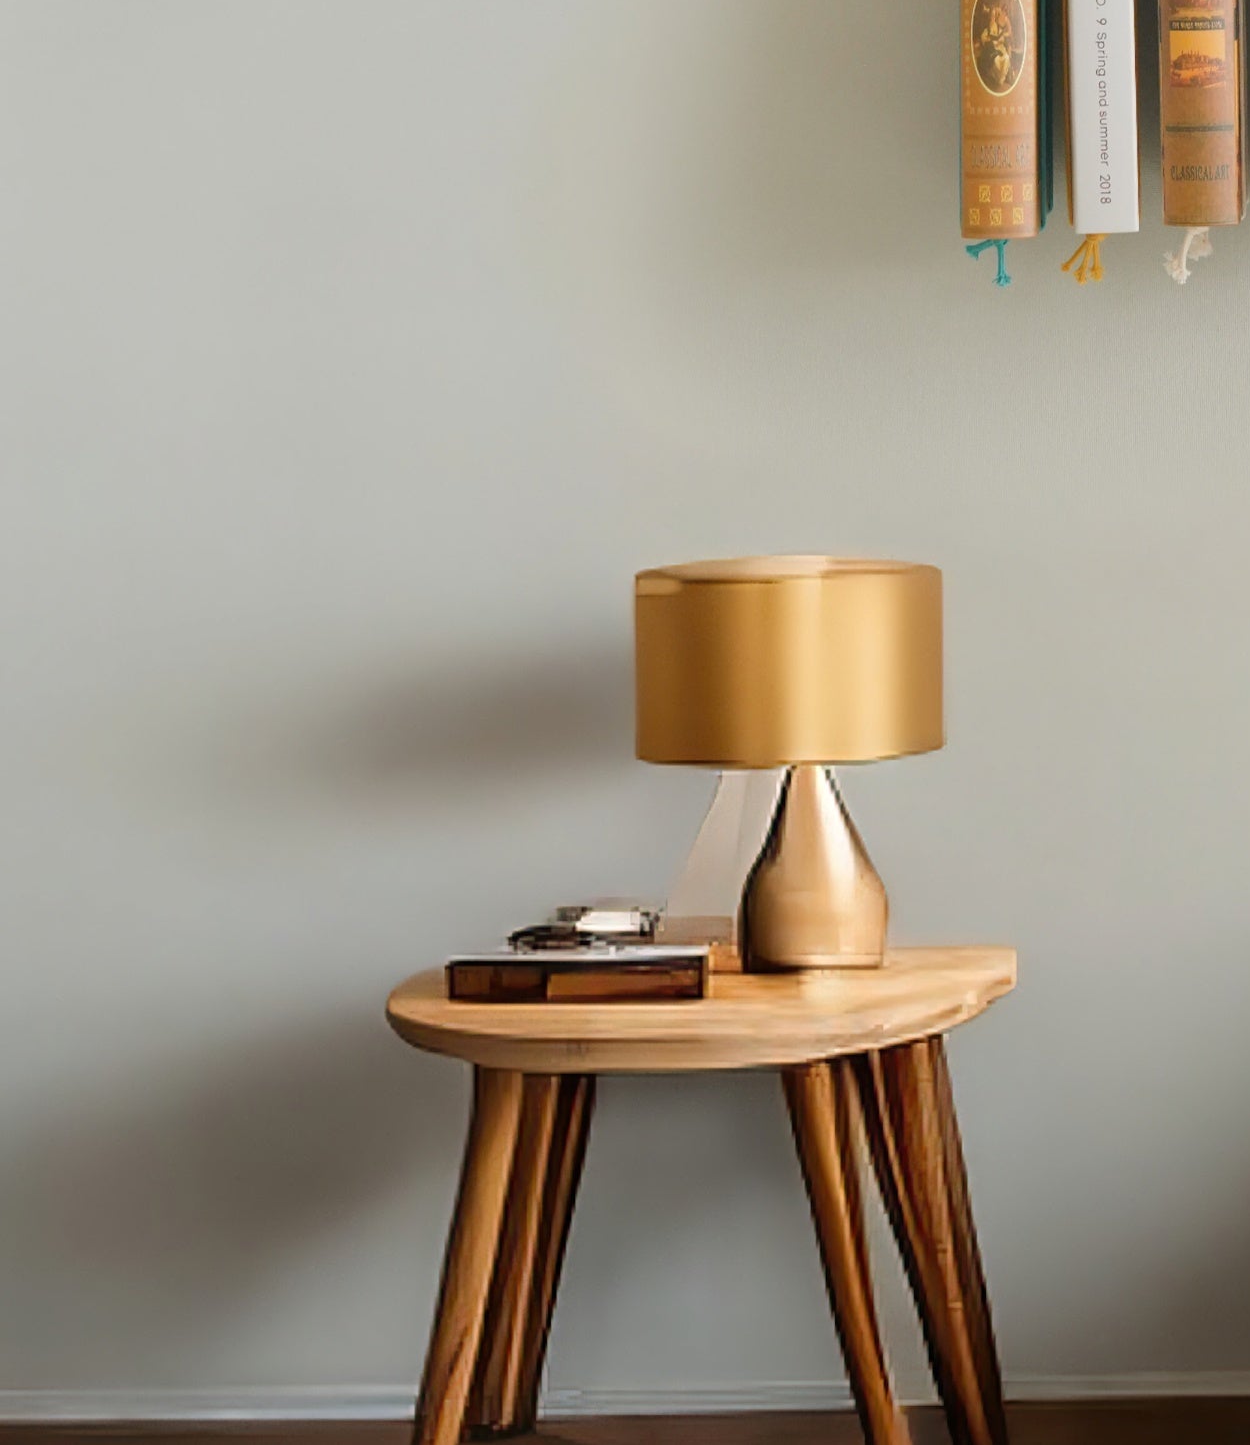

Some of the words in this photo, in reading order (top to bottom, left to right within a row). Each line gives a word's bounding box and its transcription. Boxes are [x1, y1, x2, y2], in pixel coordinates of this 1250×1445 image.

[1096, 17, 1107, 26] 9
[1095, 31, 1107, 77] Spring
[1098, 80, 1107, 107] and
[1099, 110, 1109, 166] summer
[1171, 165, 1214, 182] CLASSICAL
[1214, 164, 1230, 181] ART
[1099, 174, 1112, 205] 2018
